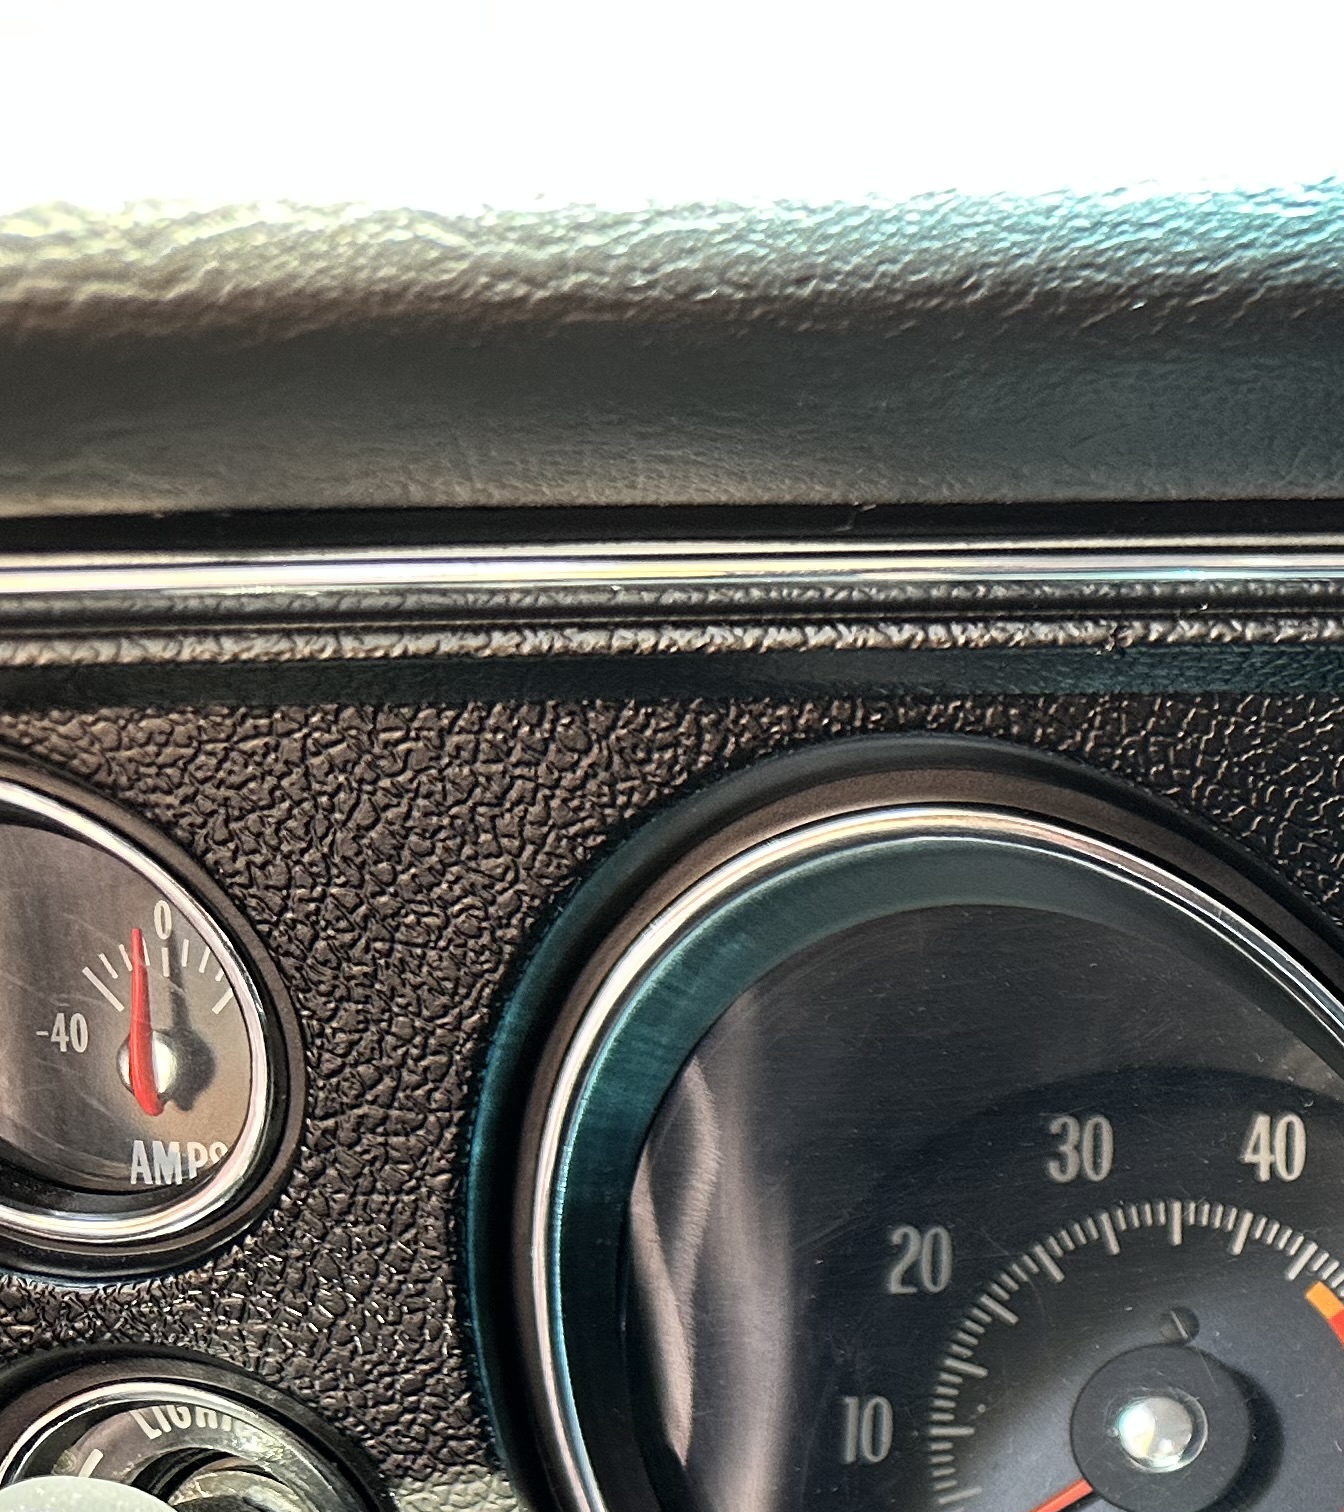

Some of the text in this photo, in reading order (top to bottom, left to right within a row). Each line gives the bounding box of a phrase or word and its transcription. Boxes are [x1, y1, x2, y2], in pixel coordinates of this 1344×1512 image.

[153, 900, 172, 940] 0
[1048, 1114, 1114, 1182] 30
[1243, 1113, 1306, 1181] 40
[888, 1226, 952, 1294] 20
[842, 1396, 893, 1464] 10
